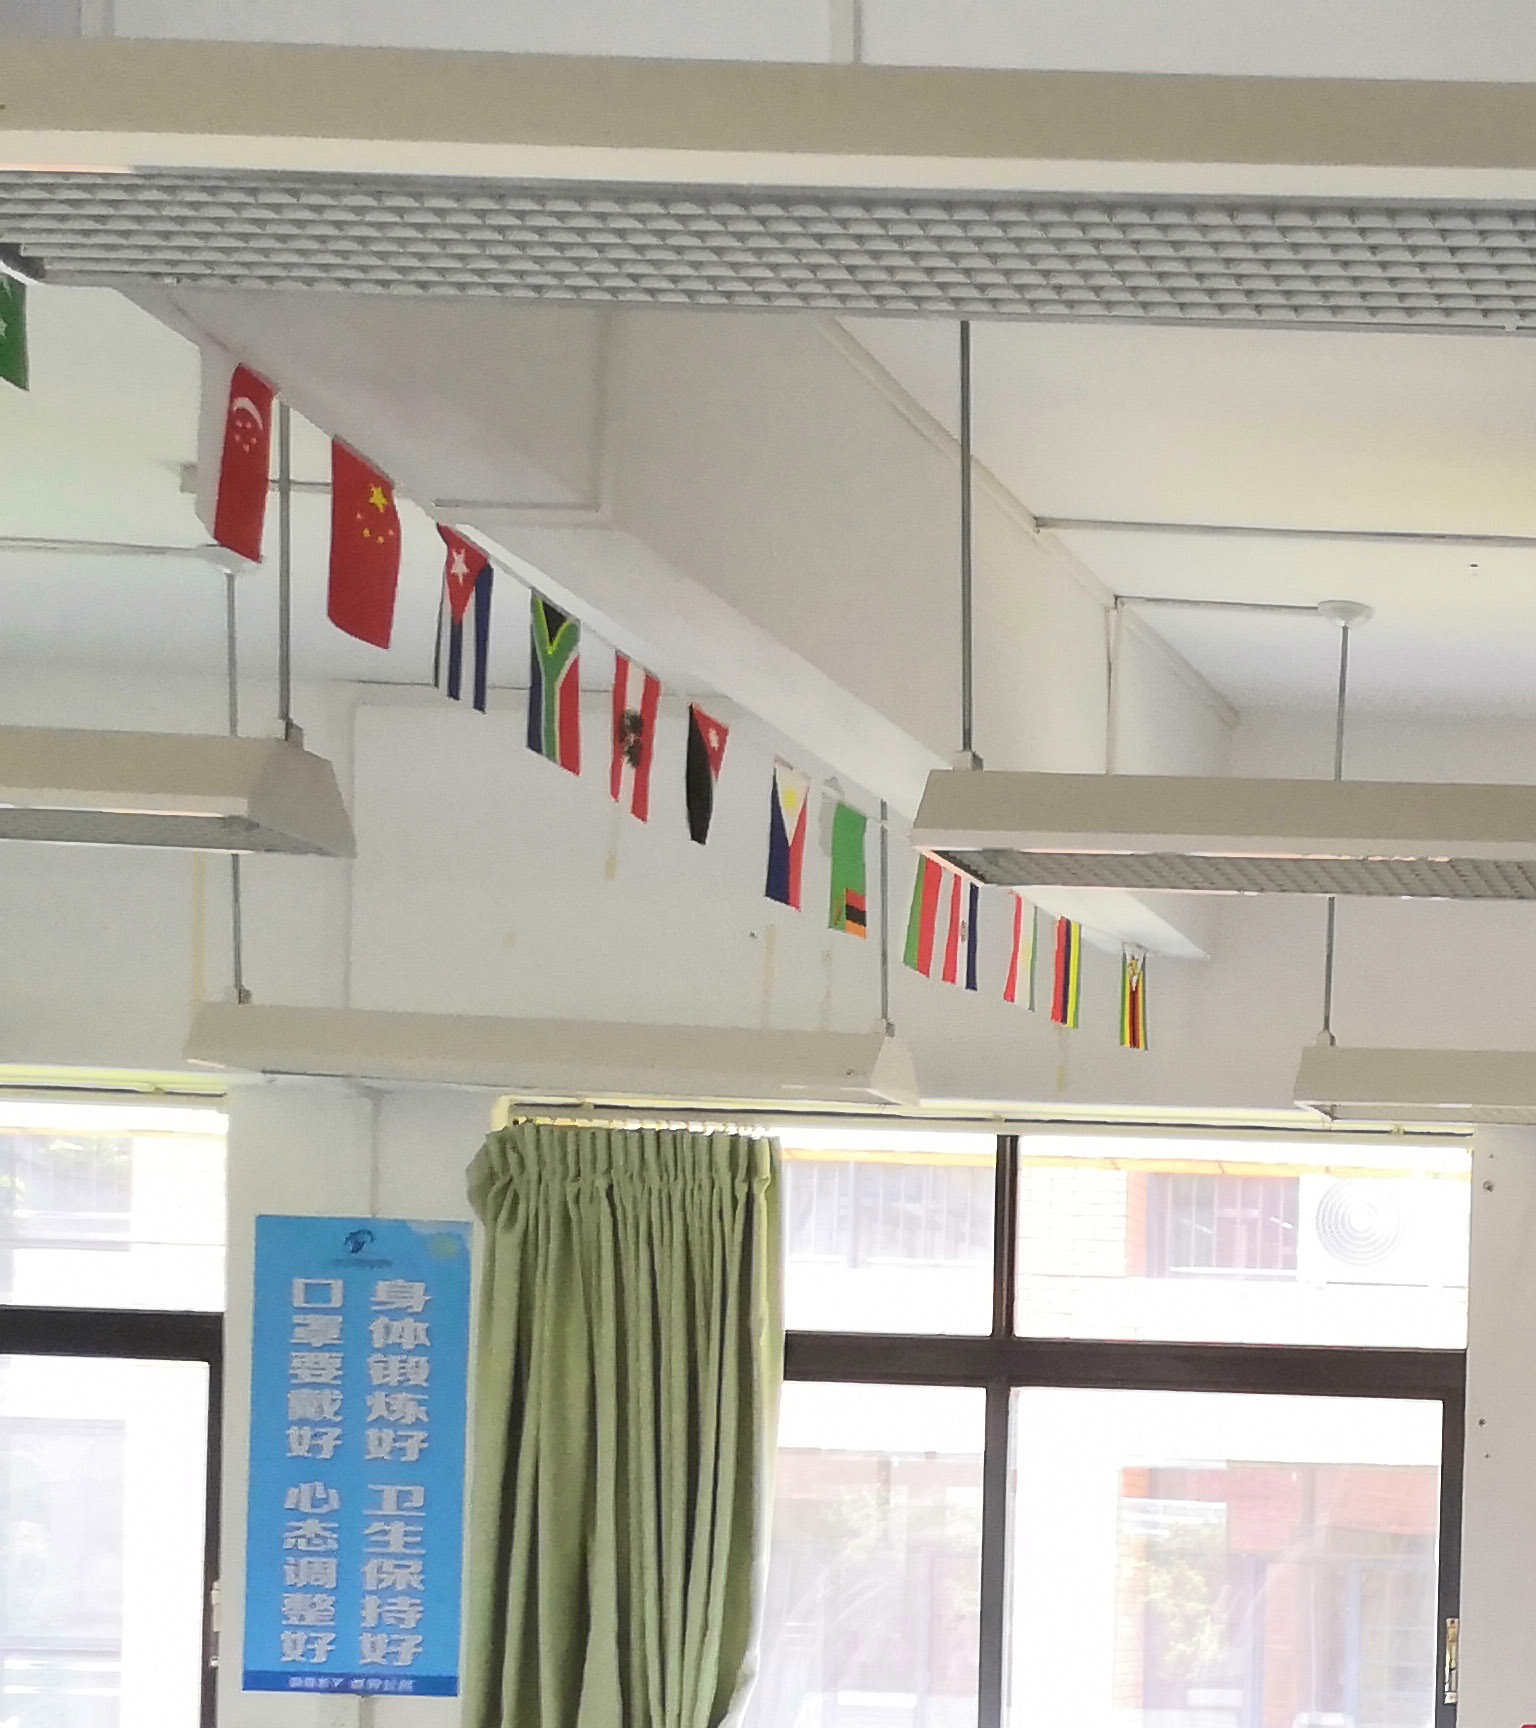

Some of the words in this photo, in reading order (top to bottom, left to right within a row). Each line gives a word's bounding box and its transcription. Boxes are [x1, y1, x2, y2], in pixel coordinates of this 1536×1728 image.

[285, 1277, 345, 1461] 口罩要戴好
[364, 1278, 432, 1463] 身体锻炼好
[280, 1480, 341, 1665] 心态调整好
[358, 1483, 427, 1667] 卫生保持好
